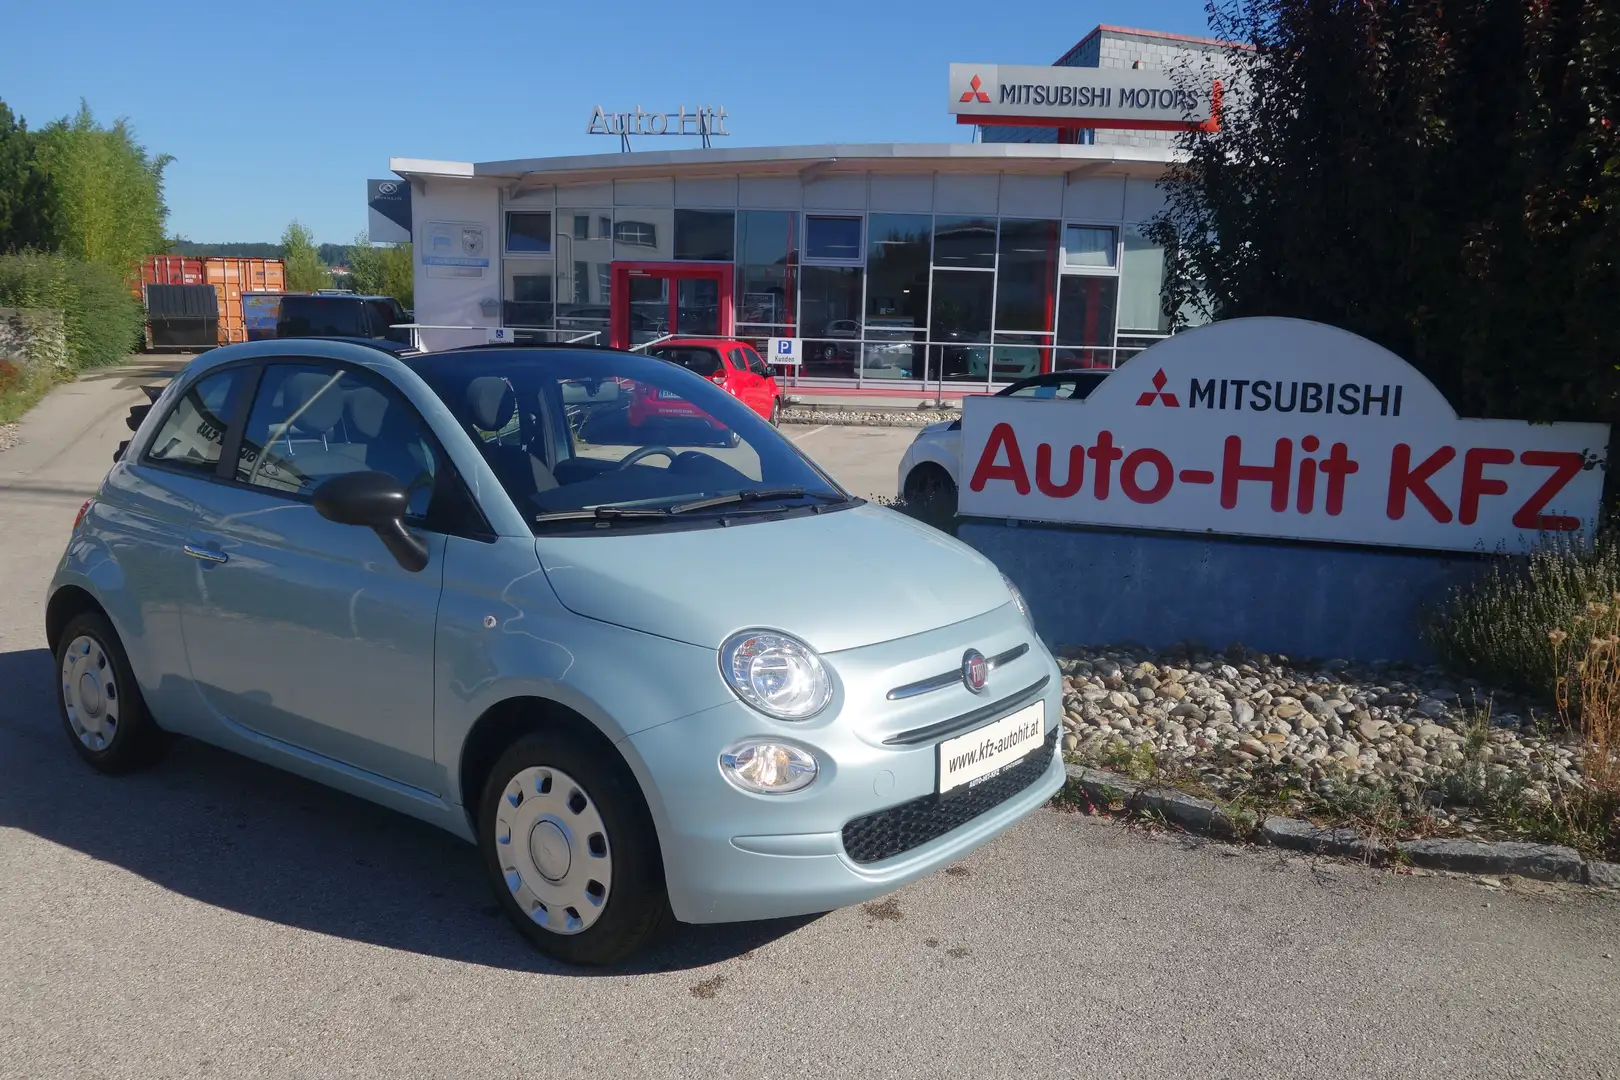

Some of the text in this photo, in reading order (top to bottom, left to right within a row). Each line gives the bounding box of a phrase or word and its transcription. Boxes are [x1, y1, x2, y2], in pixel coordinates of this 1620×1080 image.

[999, 83, 1199, 110] MITSUBISHI MOTORS
[586, 104, 730, 135] Auto Hit
[774, 355, 795, 363] Kunden
[1189, 378, 1403, 416] MITSUBISHI
[969, 421, 1583, 530] Auto-Hit KFZ
[972, 662, 988, 683] FIAT
[948, 716, 1040, 774] www.kfz-autohit.at
